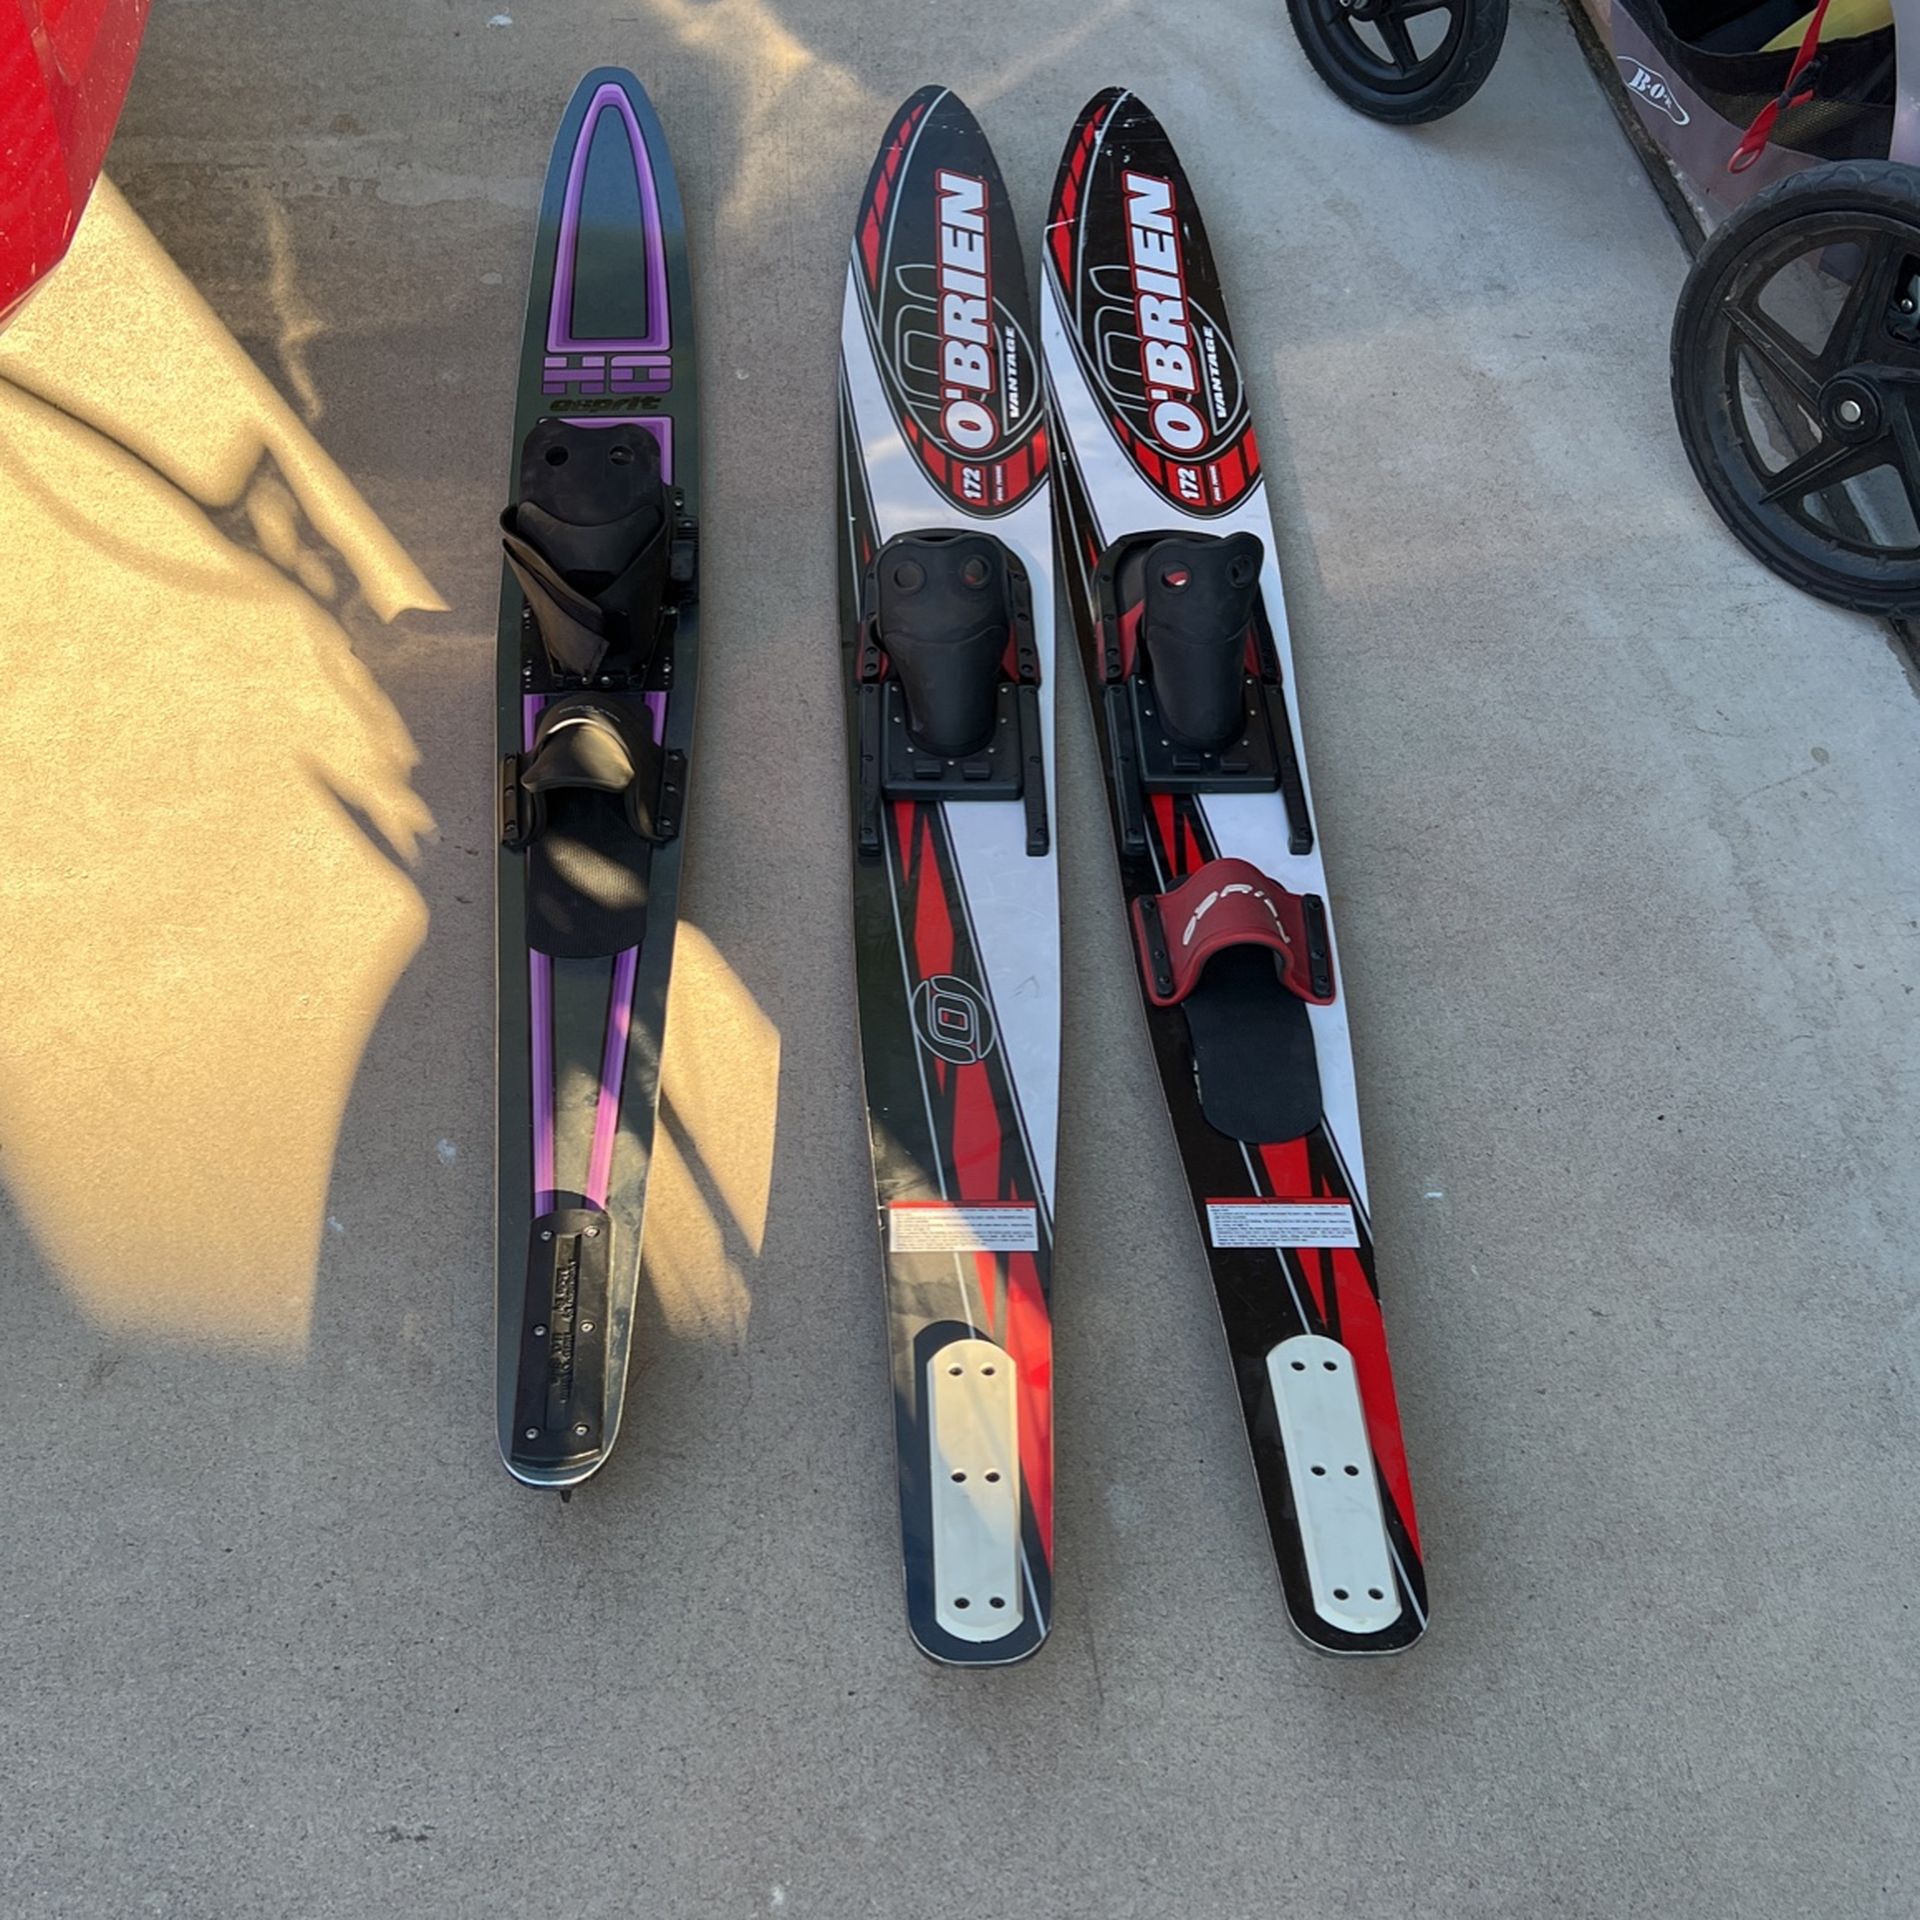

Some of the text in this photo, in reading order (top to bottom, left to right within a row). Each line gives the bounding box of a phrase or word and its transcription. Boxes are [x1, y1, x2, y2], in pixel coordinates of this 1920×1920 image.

[938, 170, 997, 452] O'BRIEN
[1125, 173, 1206, 451] O'BRIEN
[542, 355, 673, 394] HO
[1005, 326, 1020, 419] VANTAGE
[1203, 326, 1227, 419] VANTAGE
[962, 467, 982, 499] 172
[1178, 467, 1200, 500] 172
